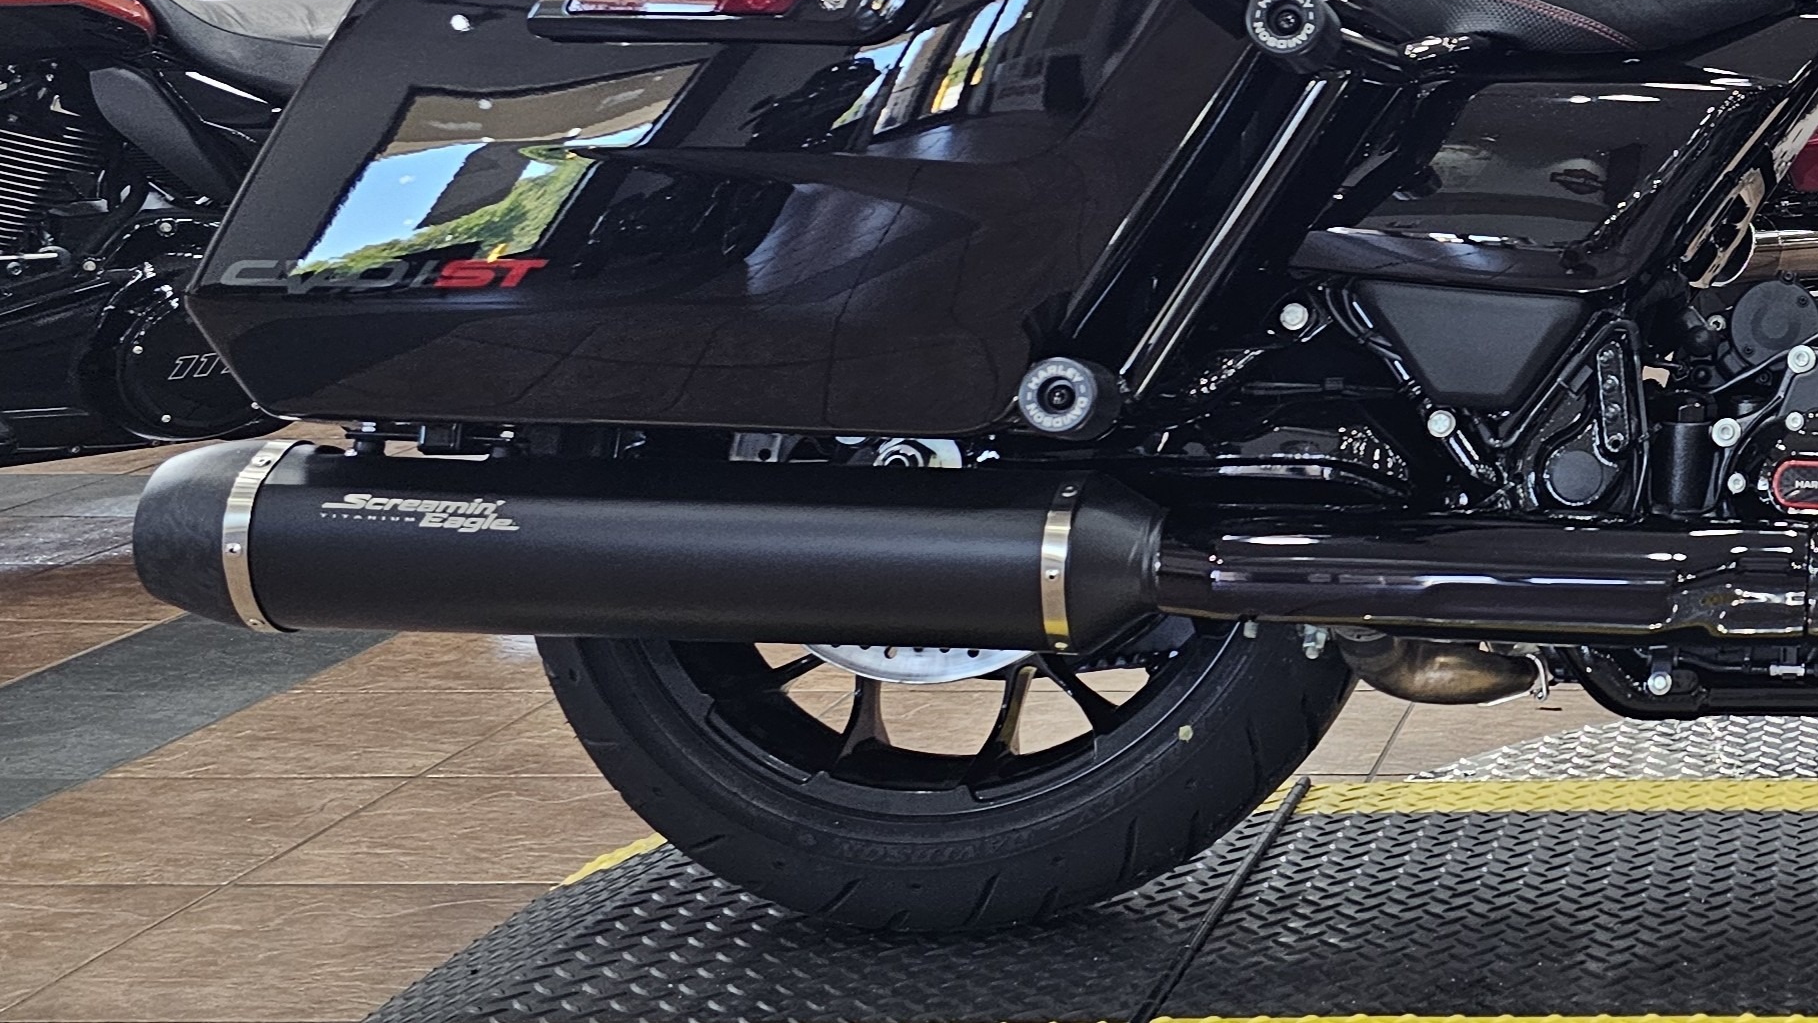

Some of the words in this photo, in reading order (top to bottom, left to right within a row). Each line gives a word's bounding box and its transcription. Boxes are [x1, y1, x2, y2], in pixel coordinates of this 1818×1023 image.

[167, 352, 232, 380] 11
[322, 493, 506, 515] Screamin'
[319, 512, 416, 522] TITANIUM
[418, 512, 520, 533] Eagle
